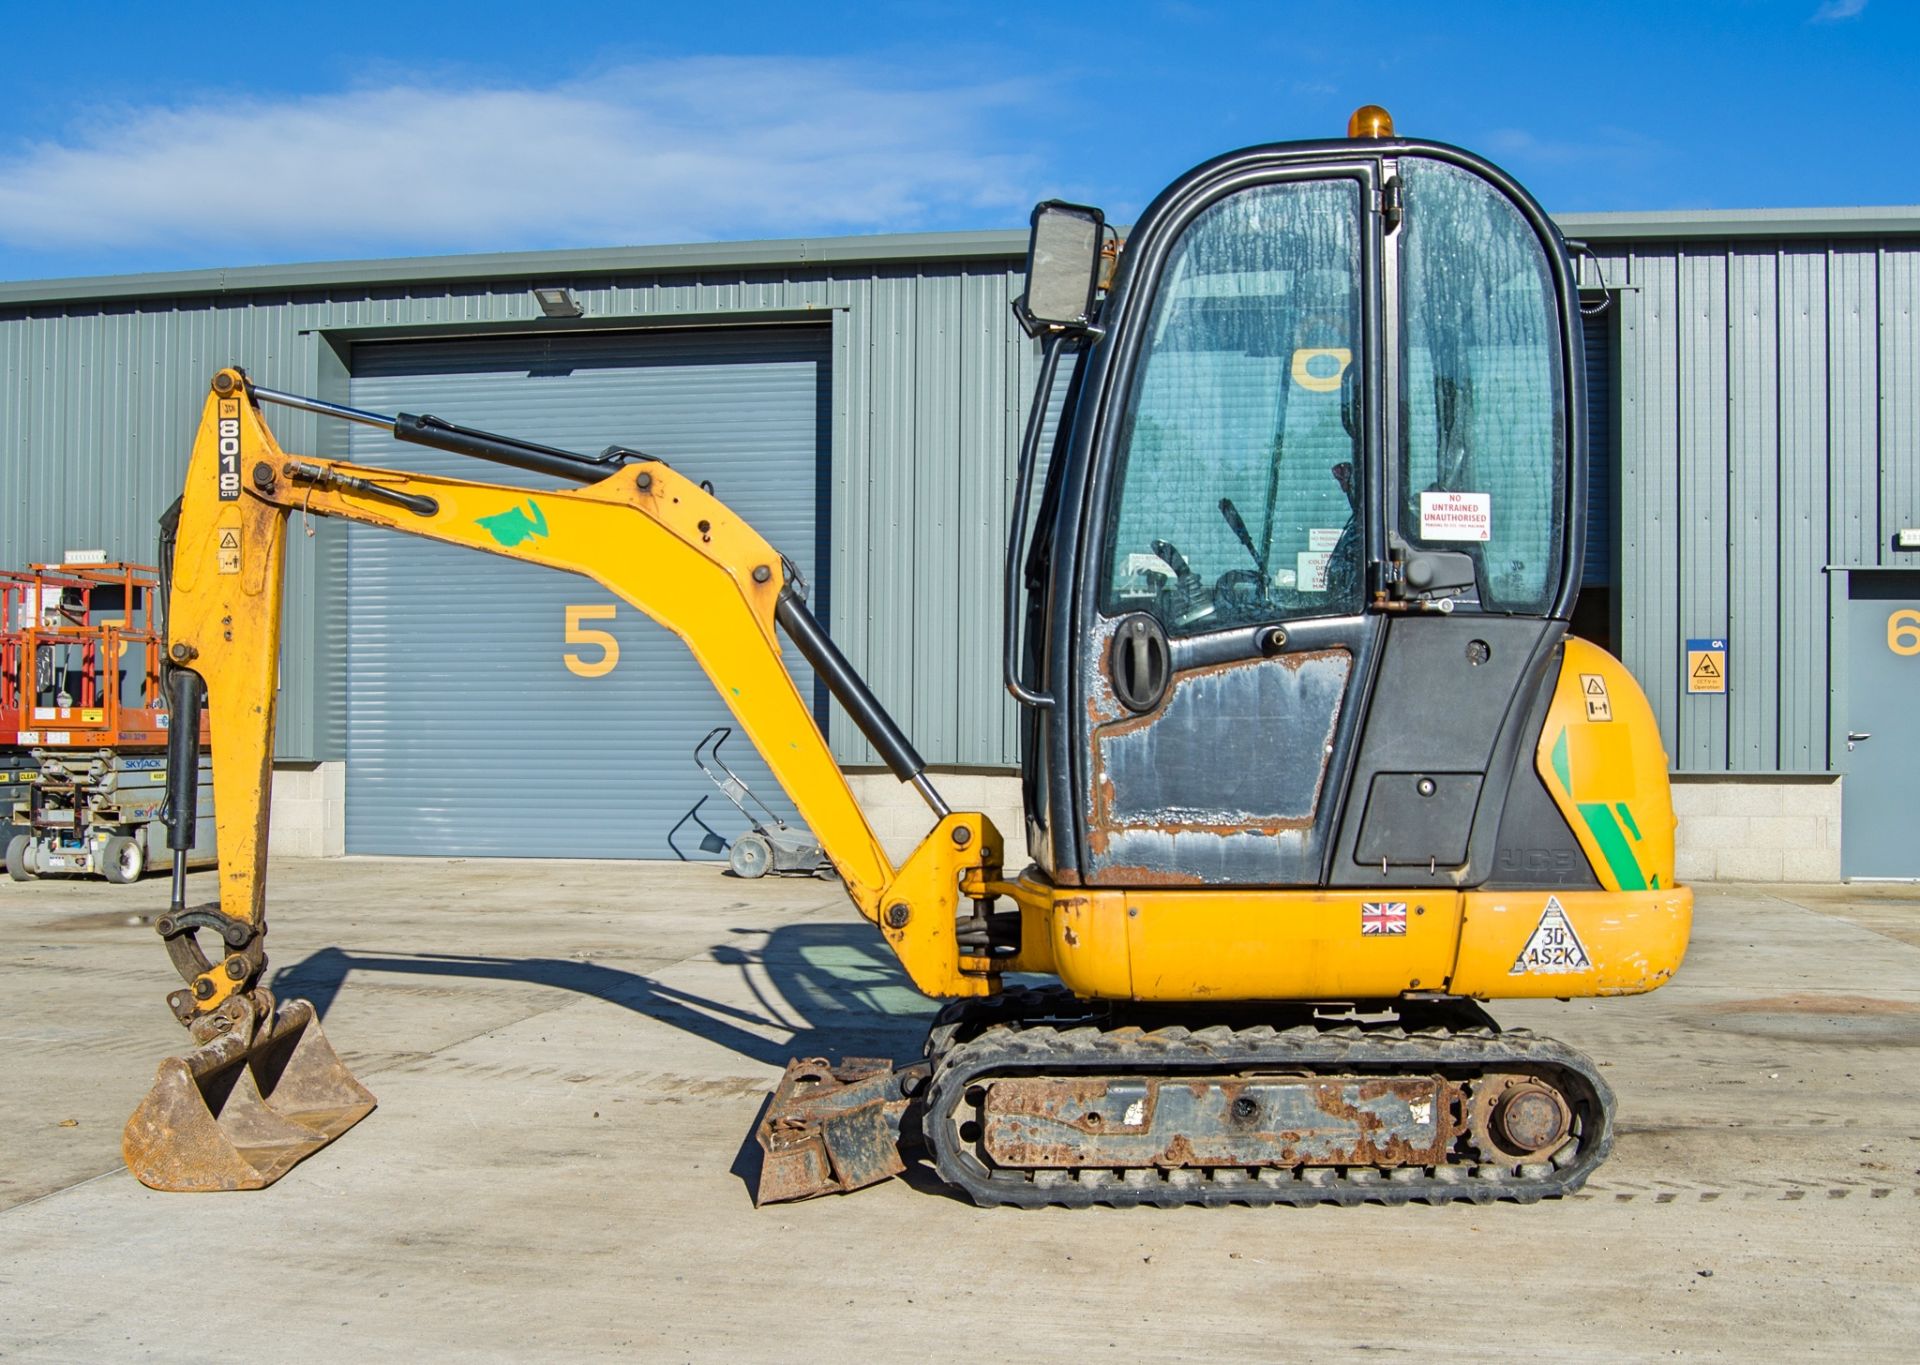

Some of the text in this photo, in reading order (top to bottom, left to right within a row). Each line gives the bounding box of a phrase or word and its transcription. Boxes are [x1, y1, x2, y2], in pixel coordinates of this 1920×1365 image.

[220, 420, 239, 490] 8018
[1431, 503, 1479, 512] UNTRAINED
[1449, 494, 1462, 502] NO
[1424, 513, 1487, 522] UNAUTHORISED
[563, 604, 620, 678] 5
[1887, 609, 1920, 656] 6
[125, 758, 161, 769] SKYJACK
[1501, 849, 1577, 872] JCB
[1528, 947, 1577, 966] AS2K
